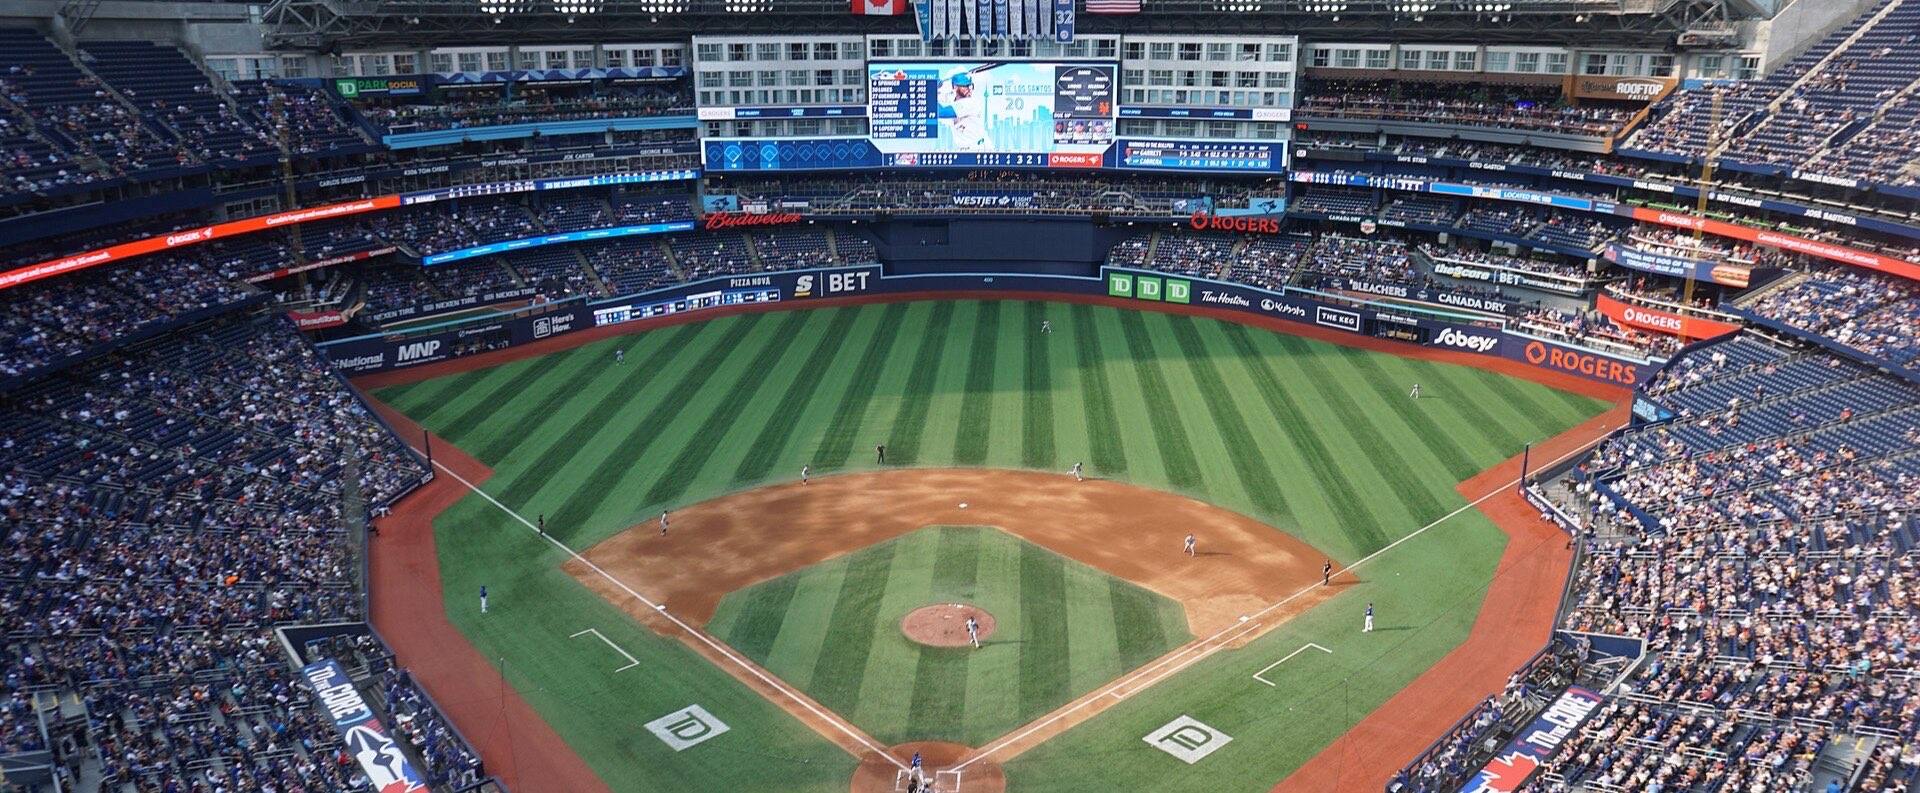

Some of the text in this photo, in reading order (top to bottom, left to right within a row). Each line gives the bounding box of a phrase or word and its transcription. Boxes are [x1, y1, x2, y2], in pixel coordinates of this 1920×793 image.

[1056, 10, 1073, 24] 32
[340, 80, 417, 95] TD PARK SOCIAL
[1616, 82, 1664, 95] ROOFTOP
[1006, 97, 1025, 110] 20
[1016, 155, 1023, 165] 3
[1026, 155, 1033, 165] 2
[1037, 155, 1042, 165] 1
[1483, 163, 1505, 171] GASTON
[319, 175, 365, 187] CARLOS DELGADO
[1562, 172, 1584, 180] GILLICK
[952, 196, 998, 207] WESTJET
[1504, 192, 1531, 200] LOCATED
[704, 212, 802, 230] Budweiser
[1211, 215, 1280, 234] ROGERS
[1666, 215, 1692, 225] ROGERS
[174, 232, 200, 242] ROGERS
[1656, 256, 1671, 265] DOG
[1682, 261, 1695, 269] THE
[730, 276, 771, 288] PIZZA NOVA
[829, 272, 870, 292] BET
[1434, 264, 1490, 280] theScore
[1499, 272, 1522, 286] BET
[1112, 278, 1130, 292] TD
[1140, 281, 1158, 295] TD
[1168, 284, 1188, 298] TD
[496, 287, 537, 300] NEXEN TIRE
[1201, 290, 1250, 307] Tim Hortons
[1352, 282, 1408, 297] BLEACHERS
[1438, 294, 1482, 309] CANADA
[1484, 301, 1506, 312] DRY
[436, 297, 477, 310] NEXEN TIRE
[1275, 302, 1306, 317] Kubota
[374, 307, 415, 321] NEXEN TIRE
[552, 313, 574, 324] Here's
[1322, 312, 1355, 325] THE KEG
[1635, 312, 1682, 330] ROGERS
[1434, 328, 1498, 352] Sobeys
[398, 340, 441, 361] MNP
[340, 353, 384, 369] National
[1550, 347, 1636, 385] ROGERS
[318, 683, 367, 720] CORE
[1542, 692, 1598, 729] CORE
[665, 710, 712, 741] TD
[1158, 725, 1213, 752] TD
[1526, 729, 1560, 750] TO
